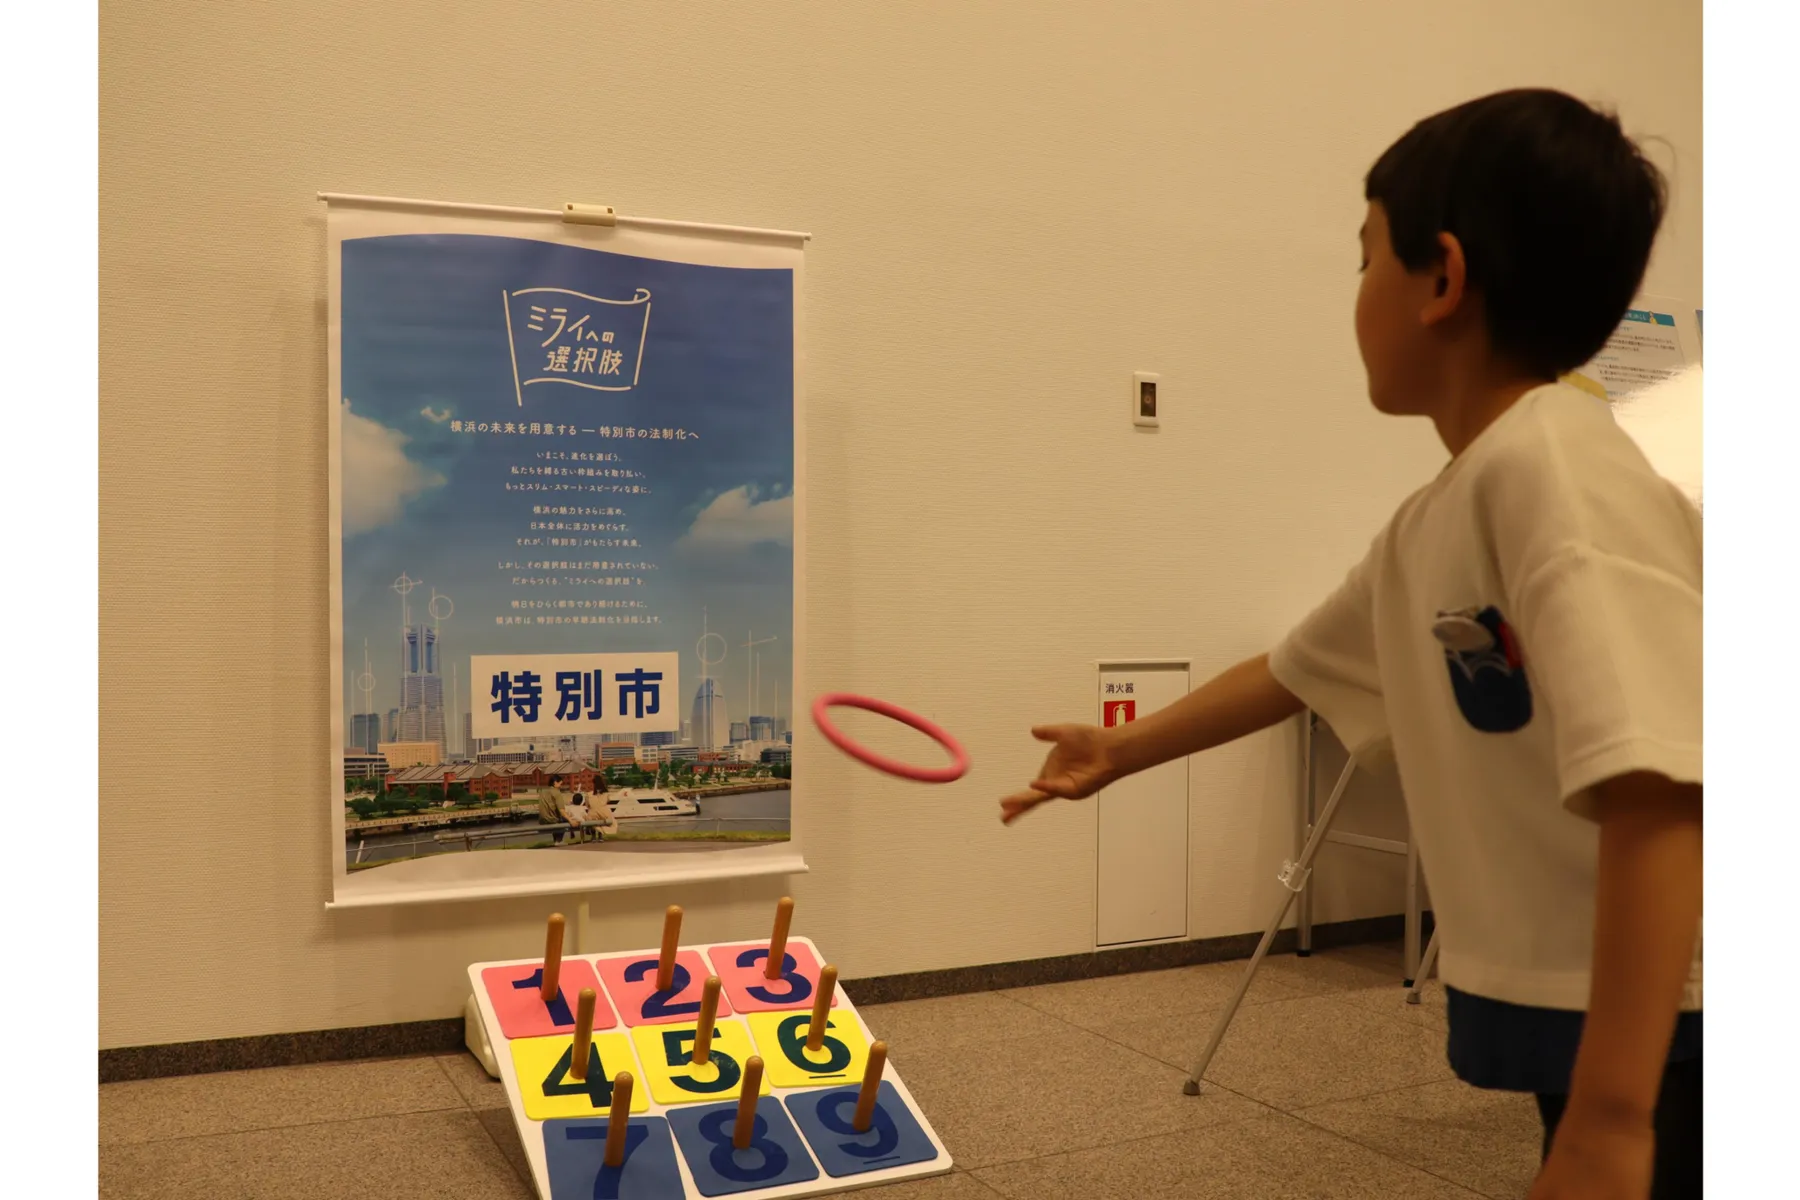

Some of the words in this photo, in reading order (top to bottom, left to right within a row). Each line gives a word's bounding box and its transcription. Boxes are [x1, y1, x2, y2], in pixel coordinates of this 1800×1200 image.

[527, 305, 615, 347] ミライへの
[543, 346, 623, 375] 選択肢
[450, 420, 577, 436] 横浜の未来を用意する
[599, 425, 700, 440] 特別市の法制化へ
[490, 668, 663, 724] 特別市
[1105, 682, 1134, 694] 消火器
[512, 968, 575, 1027] 1
[624, 960, 702, 1019] 2
[736, 948, 812, 1004] 3
[542, 1041, 615, 1108] 4
[662, 1027, 741, 1094] 5
[777, 1015, 851, 1074] 6
[566, 1124, 649, 1200] 7
[698, 1108, 789, 1183] 8
[815, 1091, 900, 1159] 9
